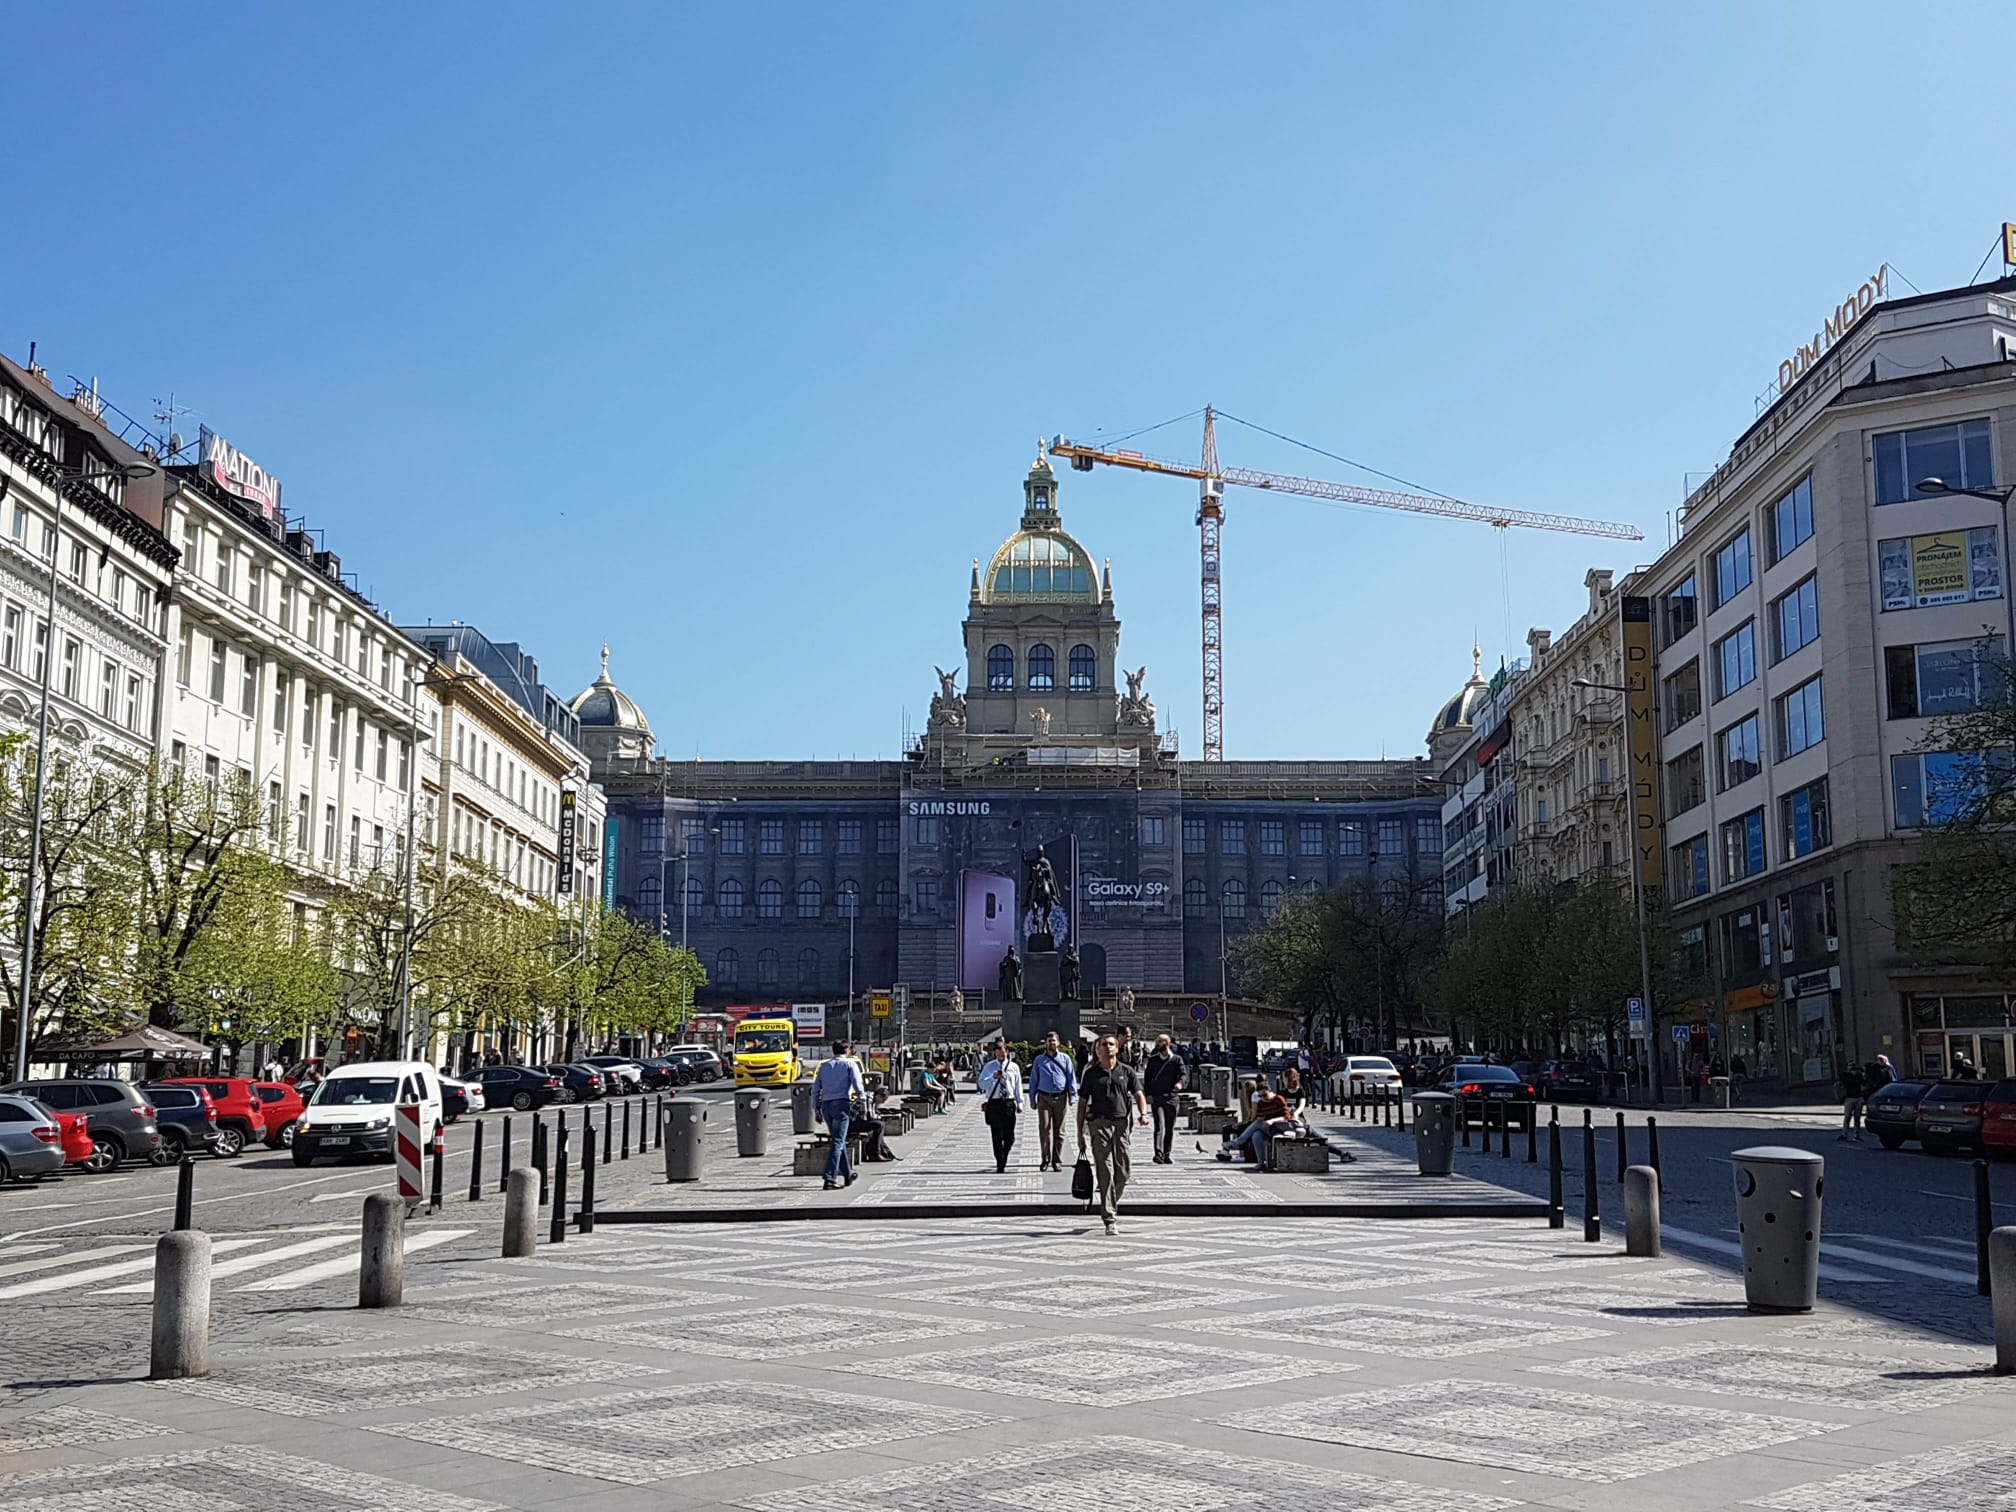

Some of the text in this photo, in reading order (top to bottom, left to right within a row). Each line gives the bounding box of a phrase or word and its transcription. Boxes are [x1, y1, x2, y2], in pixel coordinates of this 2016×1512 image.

[208, 434, 278, 508] MATTONI
[1918, 574, 1964, 587] PROSTOR
[909, 802, 990, 815] SAMSUNG
[1088, 882, 1170, 899] Galaxy S9+
[874, 1003, 888, 1012] TAXI
[760, 1023, 786, 1031] TOURS
